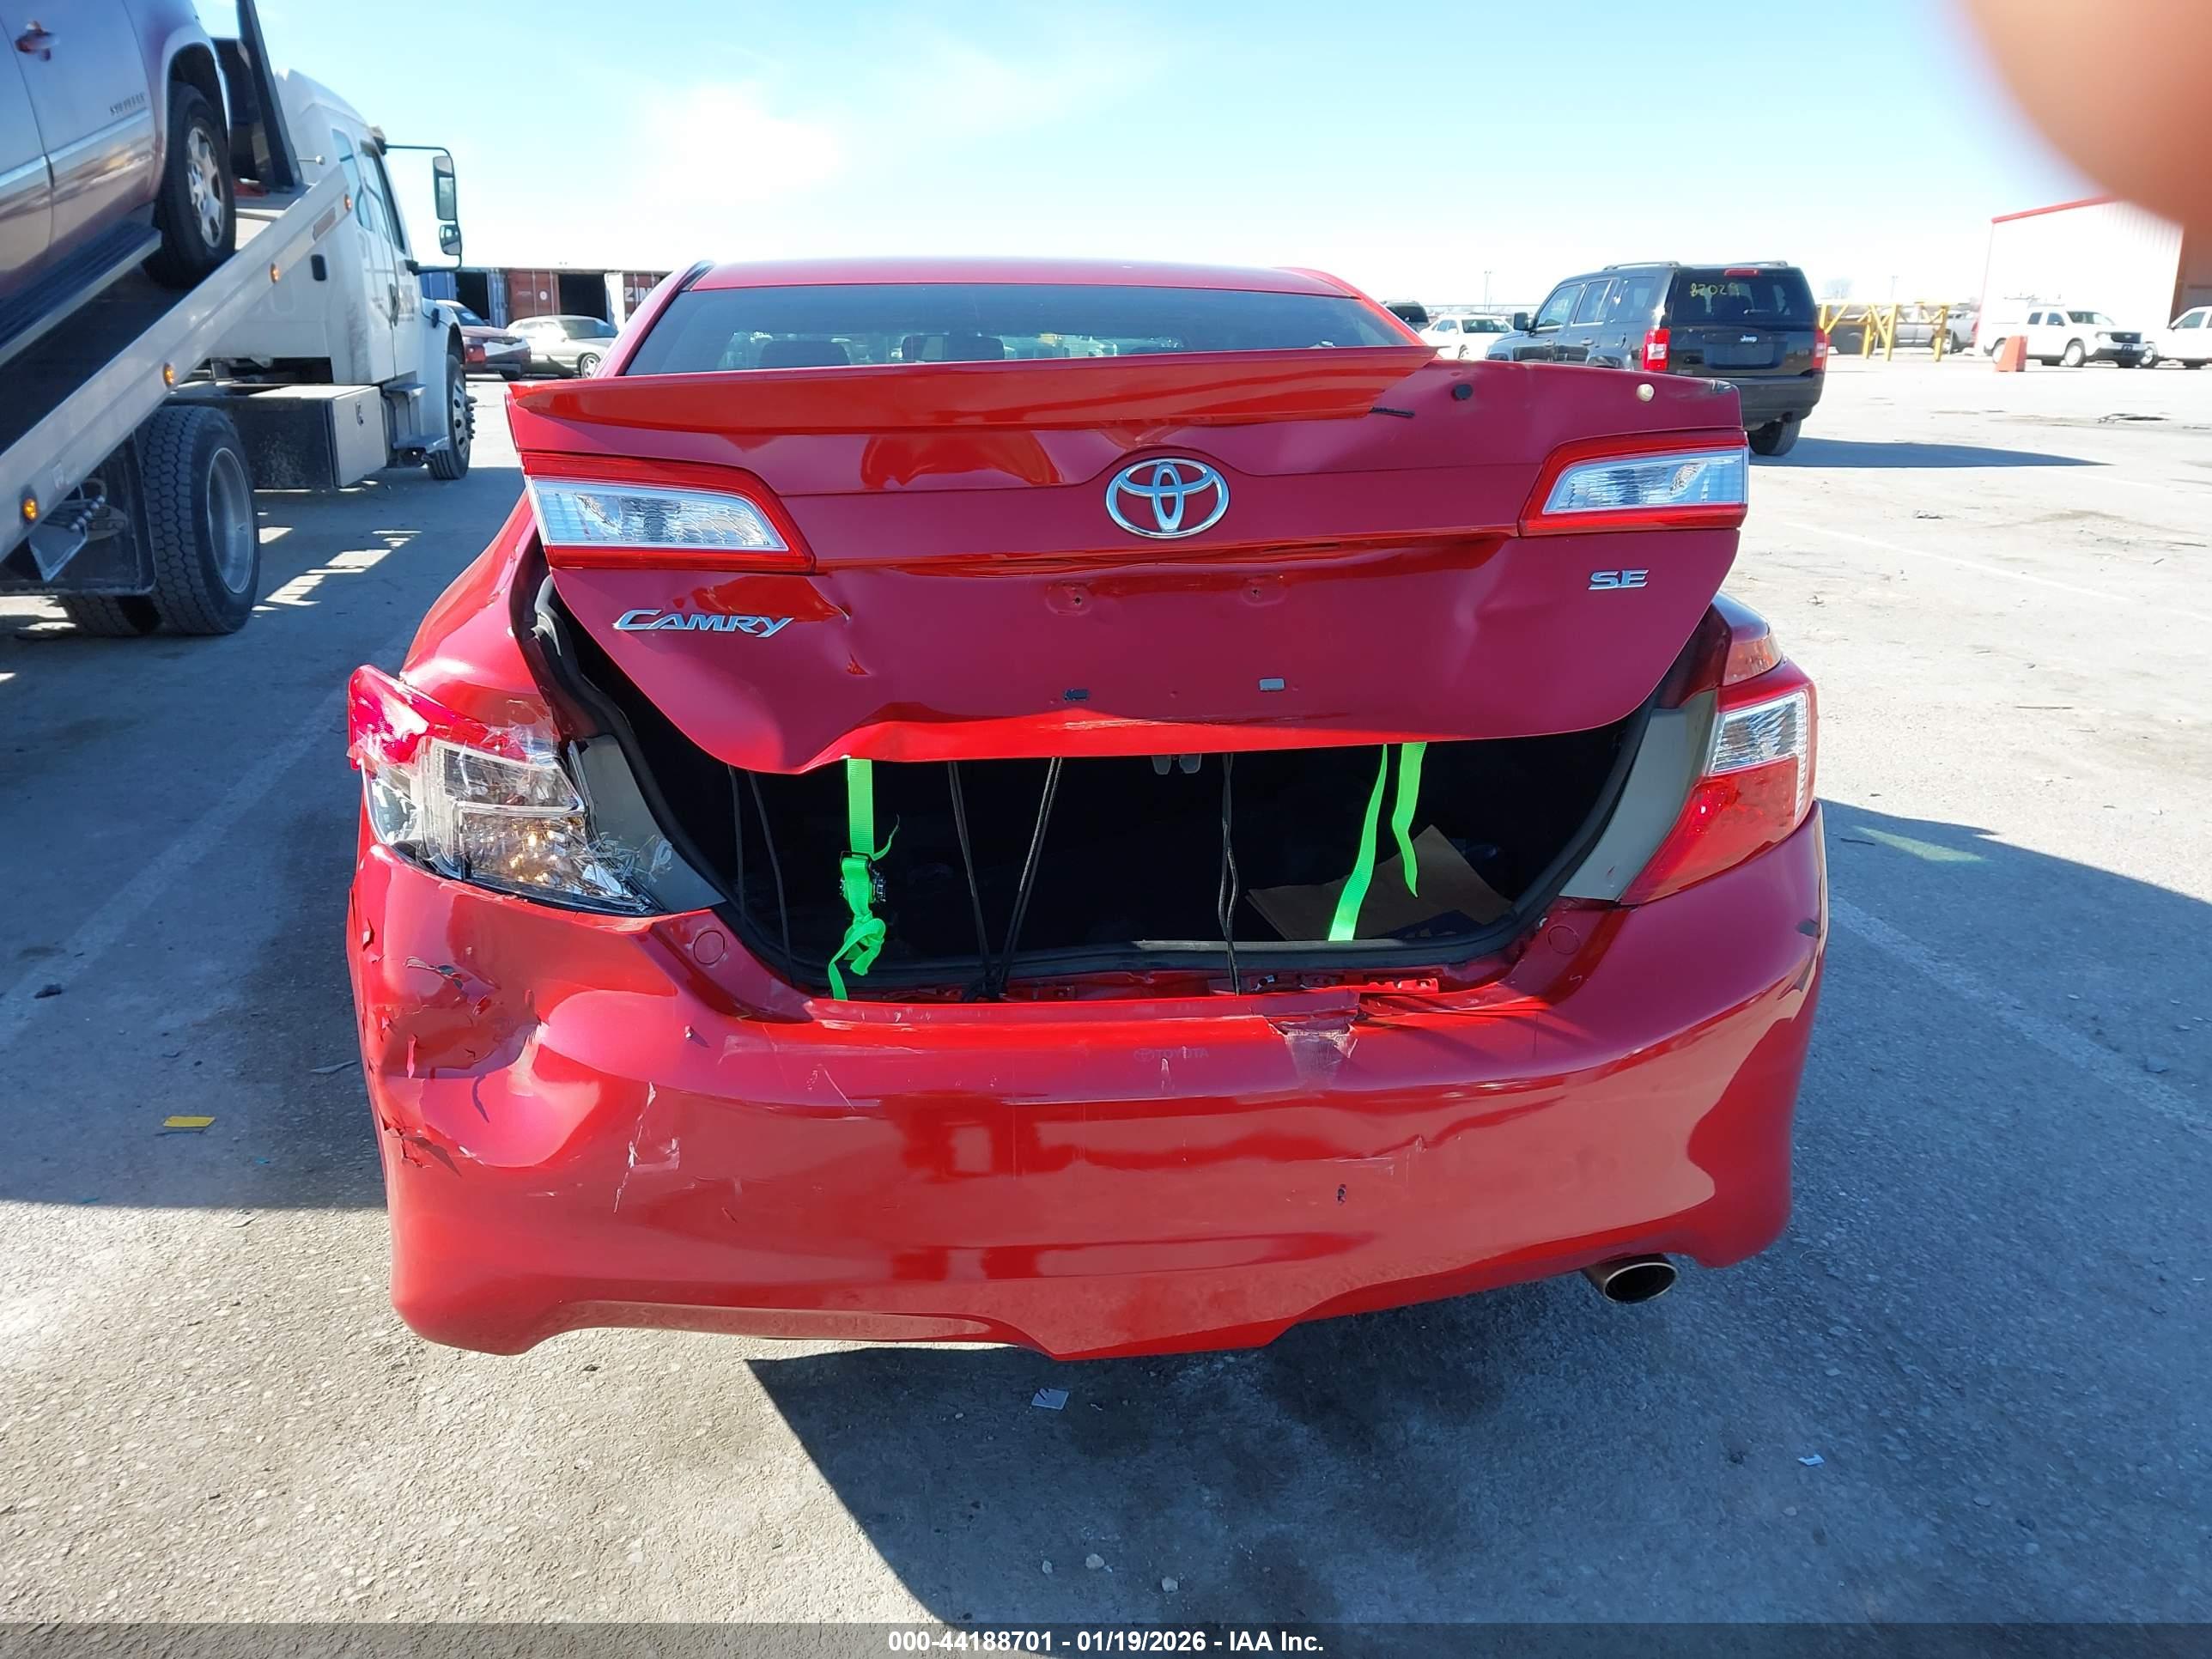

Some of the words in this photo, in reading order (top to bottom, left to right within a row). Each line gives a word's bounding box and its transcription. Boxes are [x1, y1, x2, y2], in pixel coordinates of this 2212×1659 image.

[1740, 334, 1758, 343] Jeep
[1588, 569, 1649, 590] SE
[611, 609, 794, 638] CAMRY
[1154, 1047, 1209, 1059] TOYOTA
